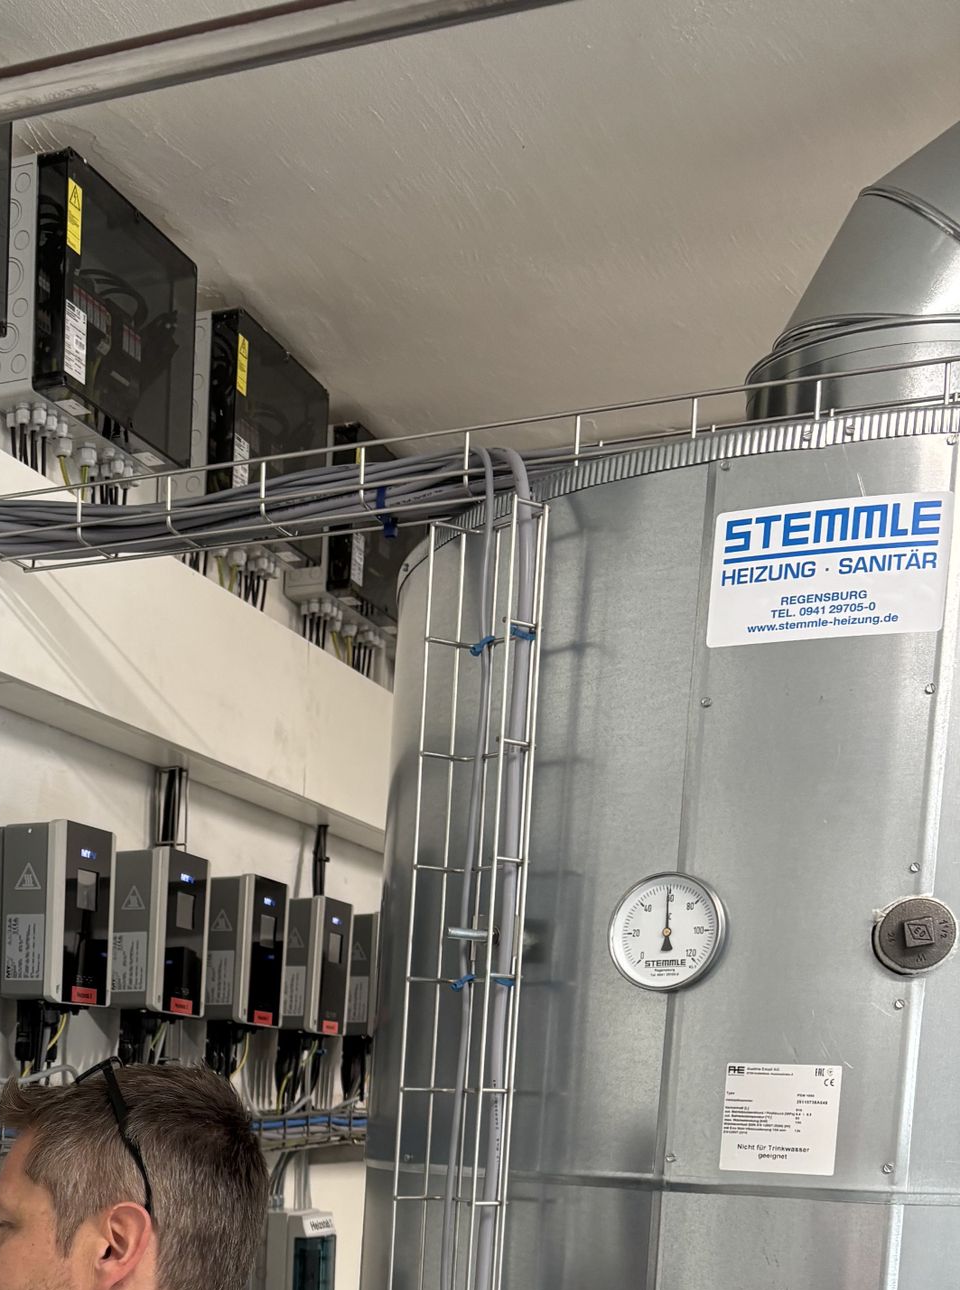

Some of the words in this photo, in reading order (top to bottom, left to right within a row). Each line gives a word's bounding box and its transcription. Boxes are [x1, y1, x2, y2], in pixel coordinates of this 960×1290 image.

[724, 500, 942, 553] STEMMLE
[721, 561, 816, 586] HEIZUNG
[838, 549, 938, 575] SANITÄR
[780, 589, 868, 606] REGENSBURG
[771, 608, 796, 619] TEL.
[799, 605, 826, 617] 0941
[828, 601, 876, 614] 29705-0
[747, 613, 899, 633] www.stemmle-heizung.de
[644, 904, 652, 913] 40
[686, 902, 695, 911] 80
[632, 929, 640, 937] 20
[693, 926, 705, 935] 100
[640, 951, 645, 960] 0
[685, 948, 696, 957] 120
[645, 959, 687, 967] STEMMLE
[737, 1143, 755, 1151] Nicht
[768, 1145, 810, 1153] Trinkwasser
